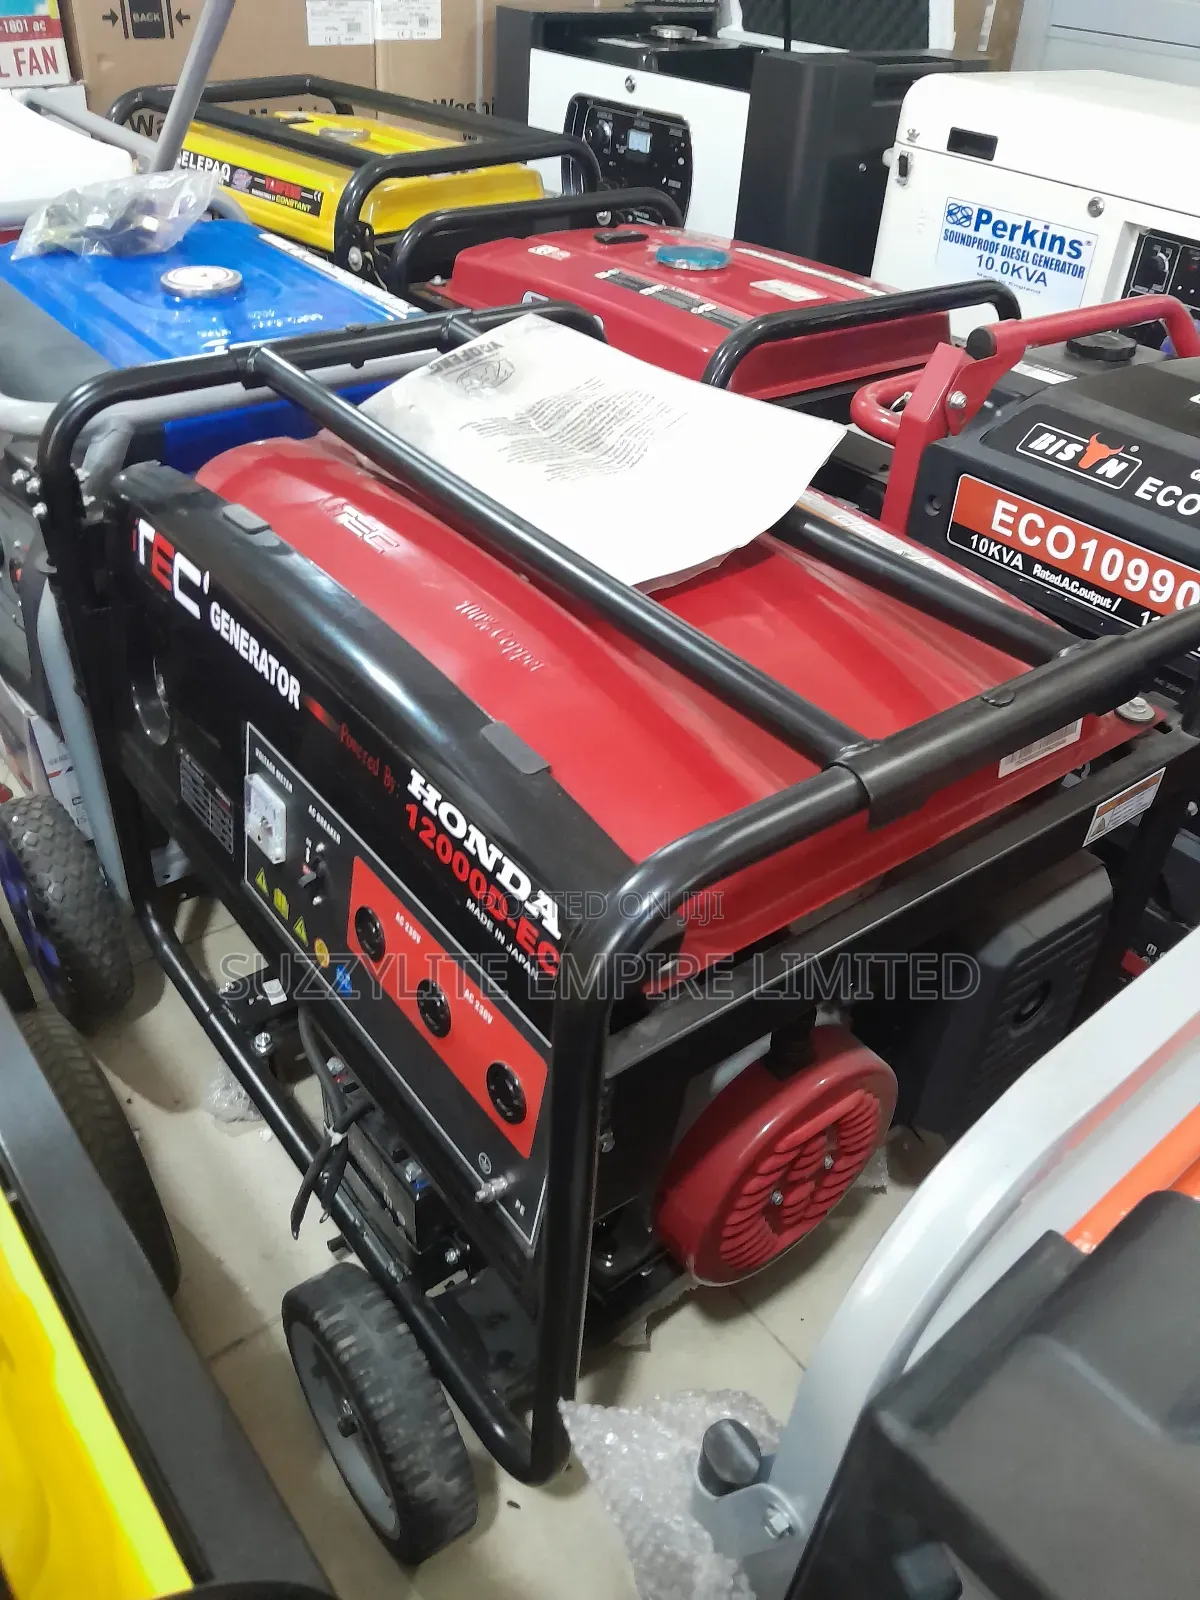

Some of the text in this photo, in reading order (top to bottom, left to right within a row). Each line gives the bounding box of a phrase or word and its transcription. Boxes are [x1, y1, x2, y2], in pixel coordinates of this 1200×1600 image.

[132, 12, 161, 22] BACK
[14, 45, 59, 77] FAN
[943, 228, 1086, 280] SOUNDPROOF DIESEL GENERATOR
[973, 207, 1083, 260] Perkins
[976, 253, 1048, 287] 10.0KVA
[969, 533, 1024, 571] 10KVA
[990, 498, 1200, 610] ECO10990
[209, 601, 302, 711] GENERATOR
[407, 768, 562, 941] HONDA
[395, 912, 422, 944] AC 230V
[466, 897, 539, 981] MADE IN JAPAN
[463, 988, 493, 1025] AC 230V
